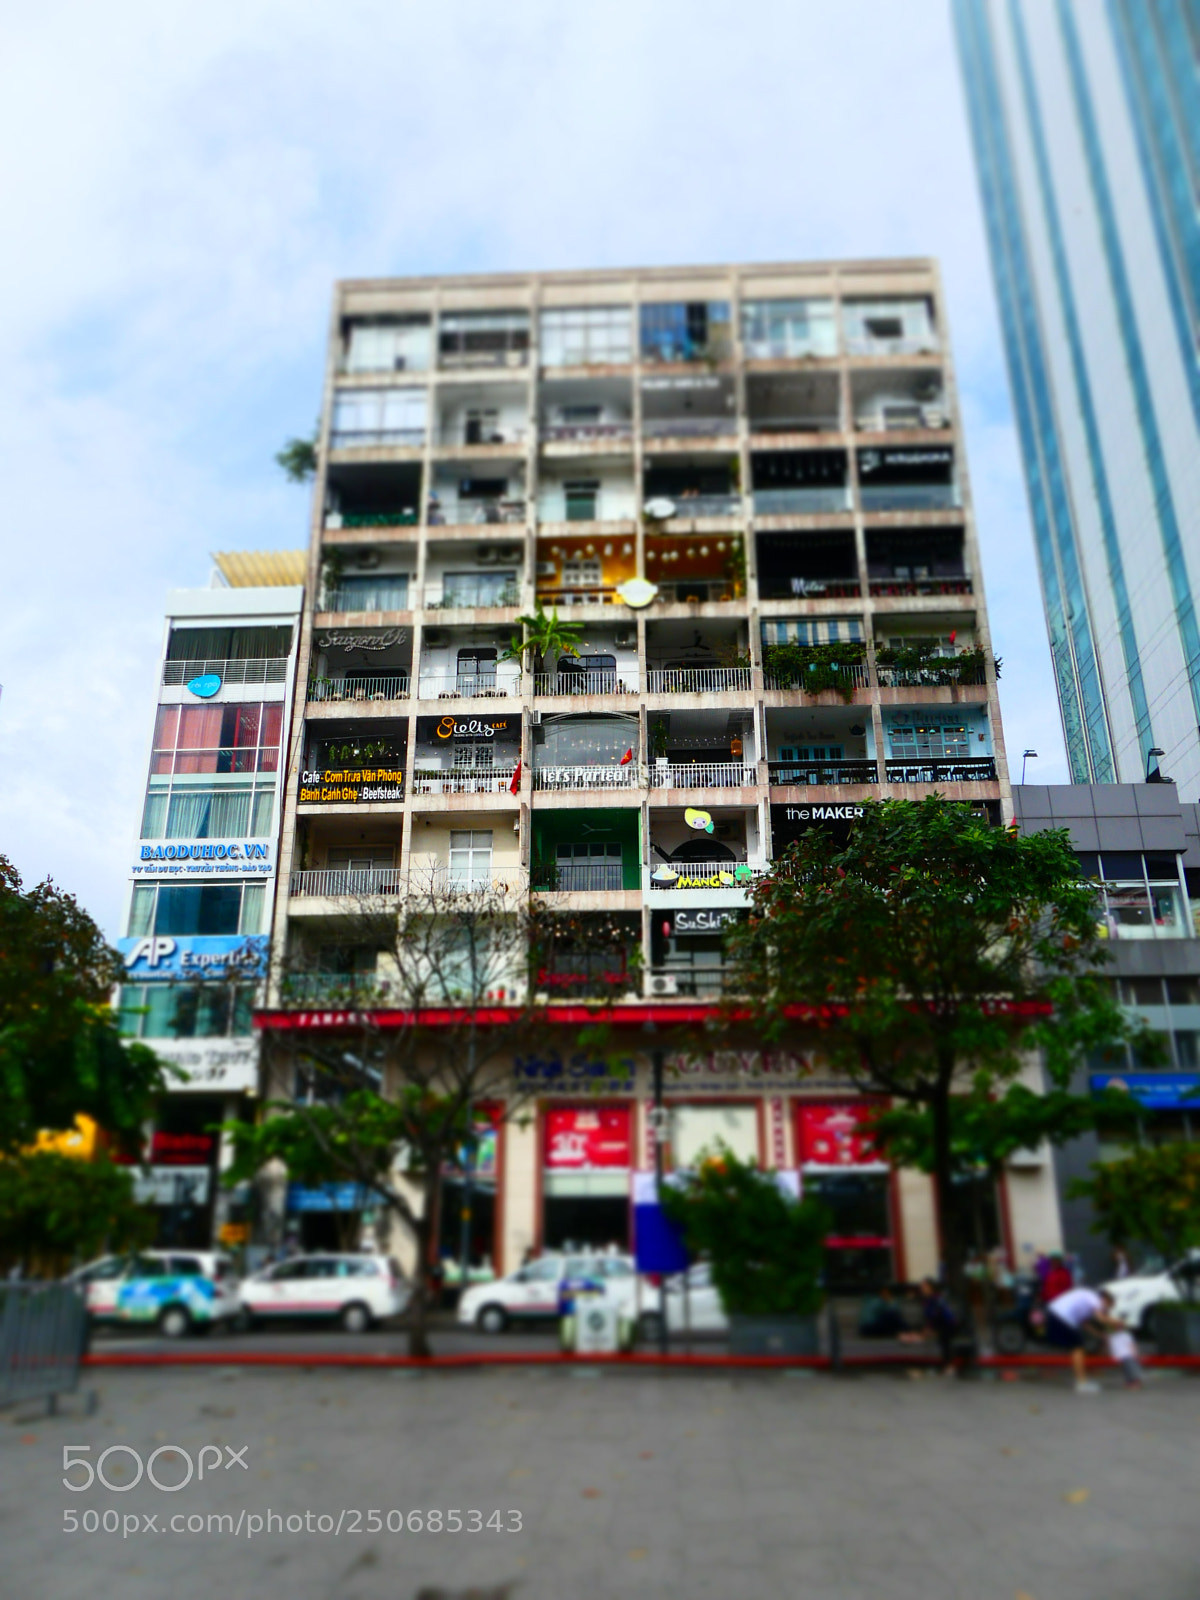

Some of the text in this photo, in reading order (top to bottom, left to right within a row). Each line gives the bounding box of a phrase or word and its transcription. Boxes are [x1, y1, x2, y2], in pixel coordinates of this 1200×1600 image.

[302, 771, 320, 783] Cafe
[786, 807, 864, 820] the MAKER
[140, 844, 267, 860] BAODUHOC.VN
